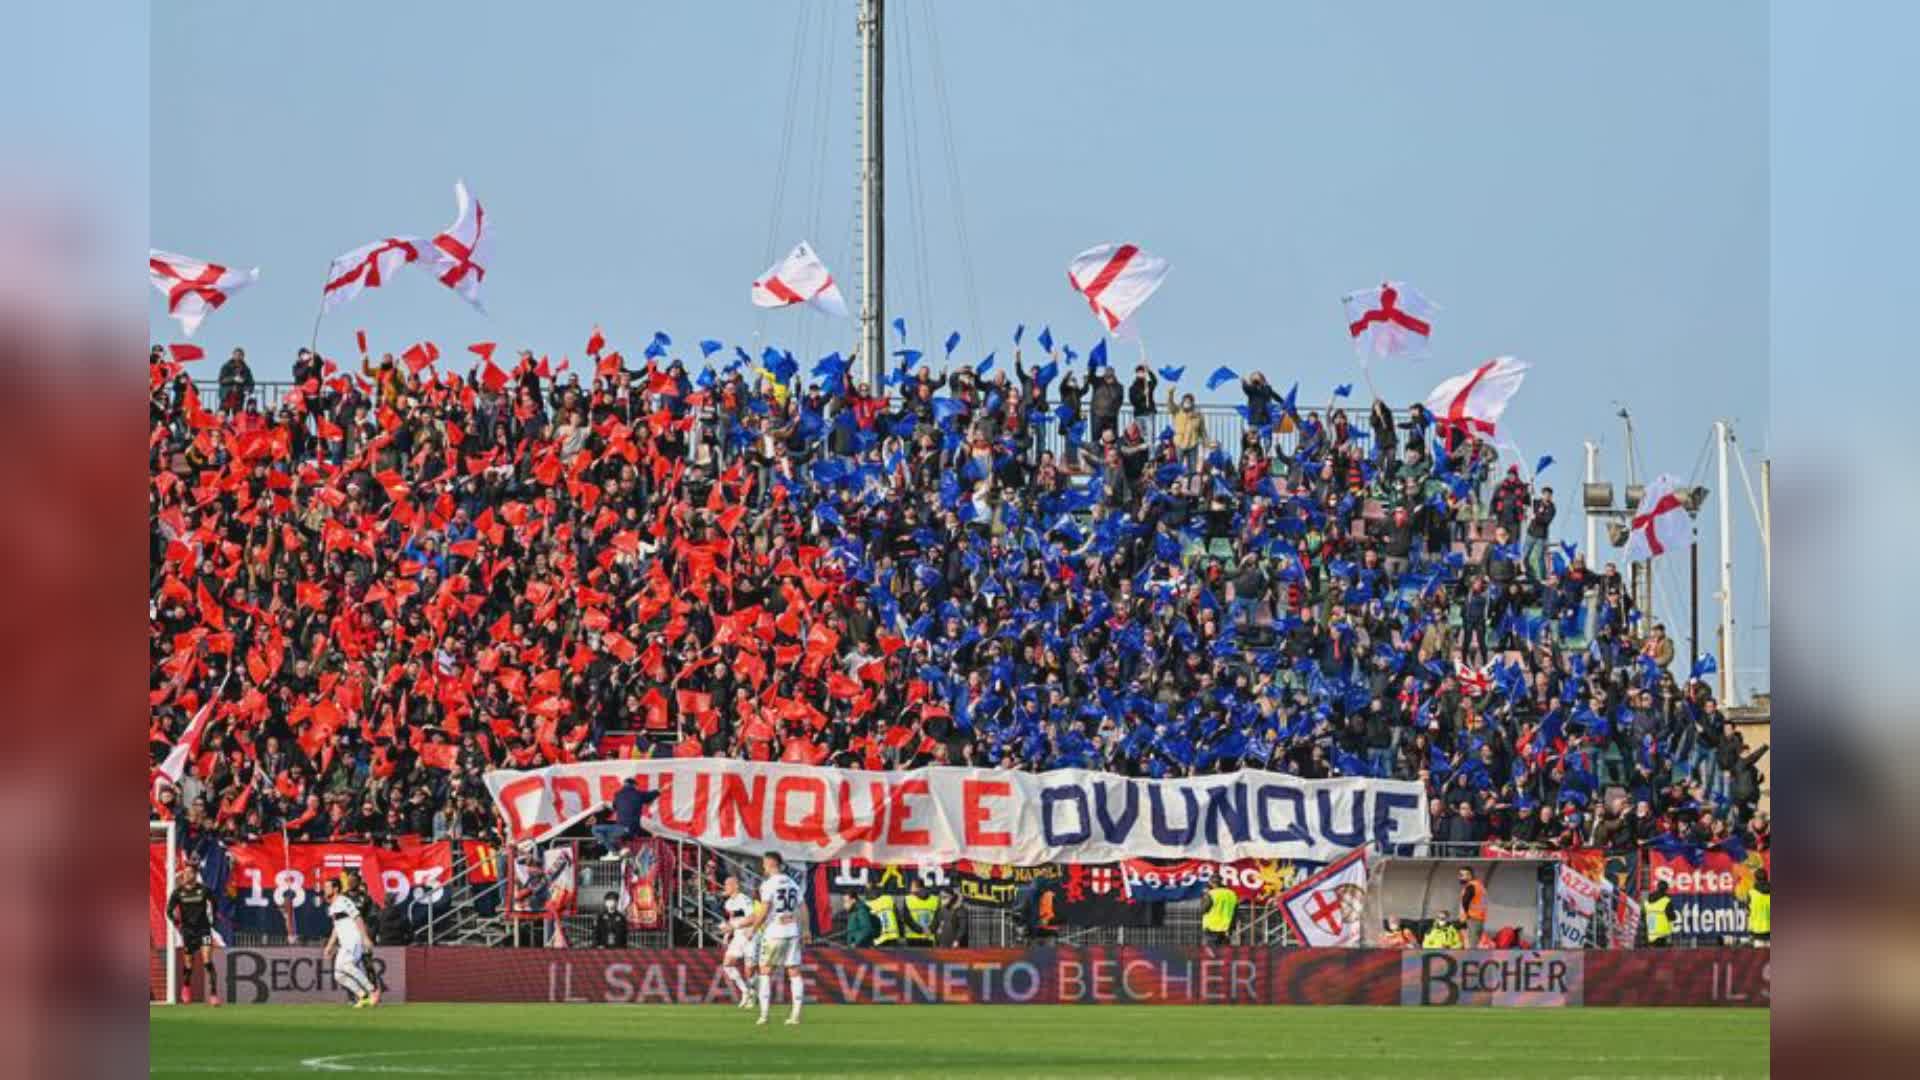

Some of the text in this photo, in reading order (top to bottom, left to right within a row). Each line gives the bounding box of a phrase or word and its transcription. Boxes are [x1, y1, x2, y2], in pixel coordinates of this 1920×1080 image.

[962, 779, 1012, 847] E
[1040, 781, 1417, 857] OVUNQUE
[1655, 866, 1734, 890] Sette
[226, 951, 389, 1005] BECHR
[551, 964, 587, 1002] IL
[833, 962, 1041, 1002] VENETO
[1059, 946, 1257, 999] BECHÈR
[1712, 961, 1748, 1000] IL
